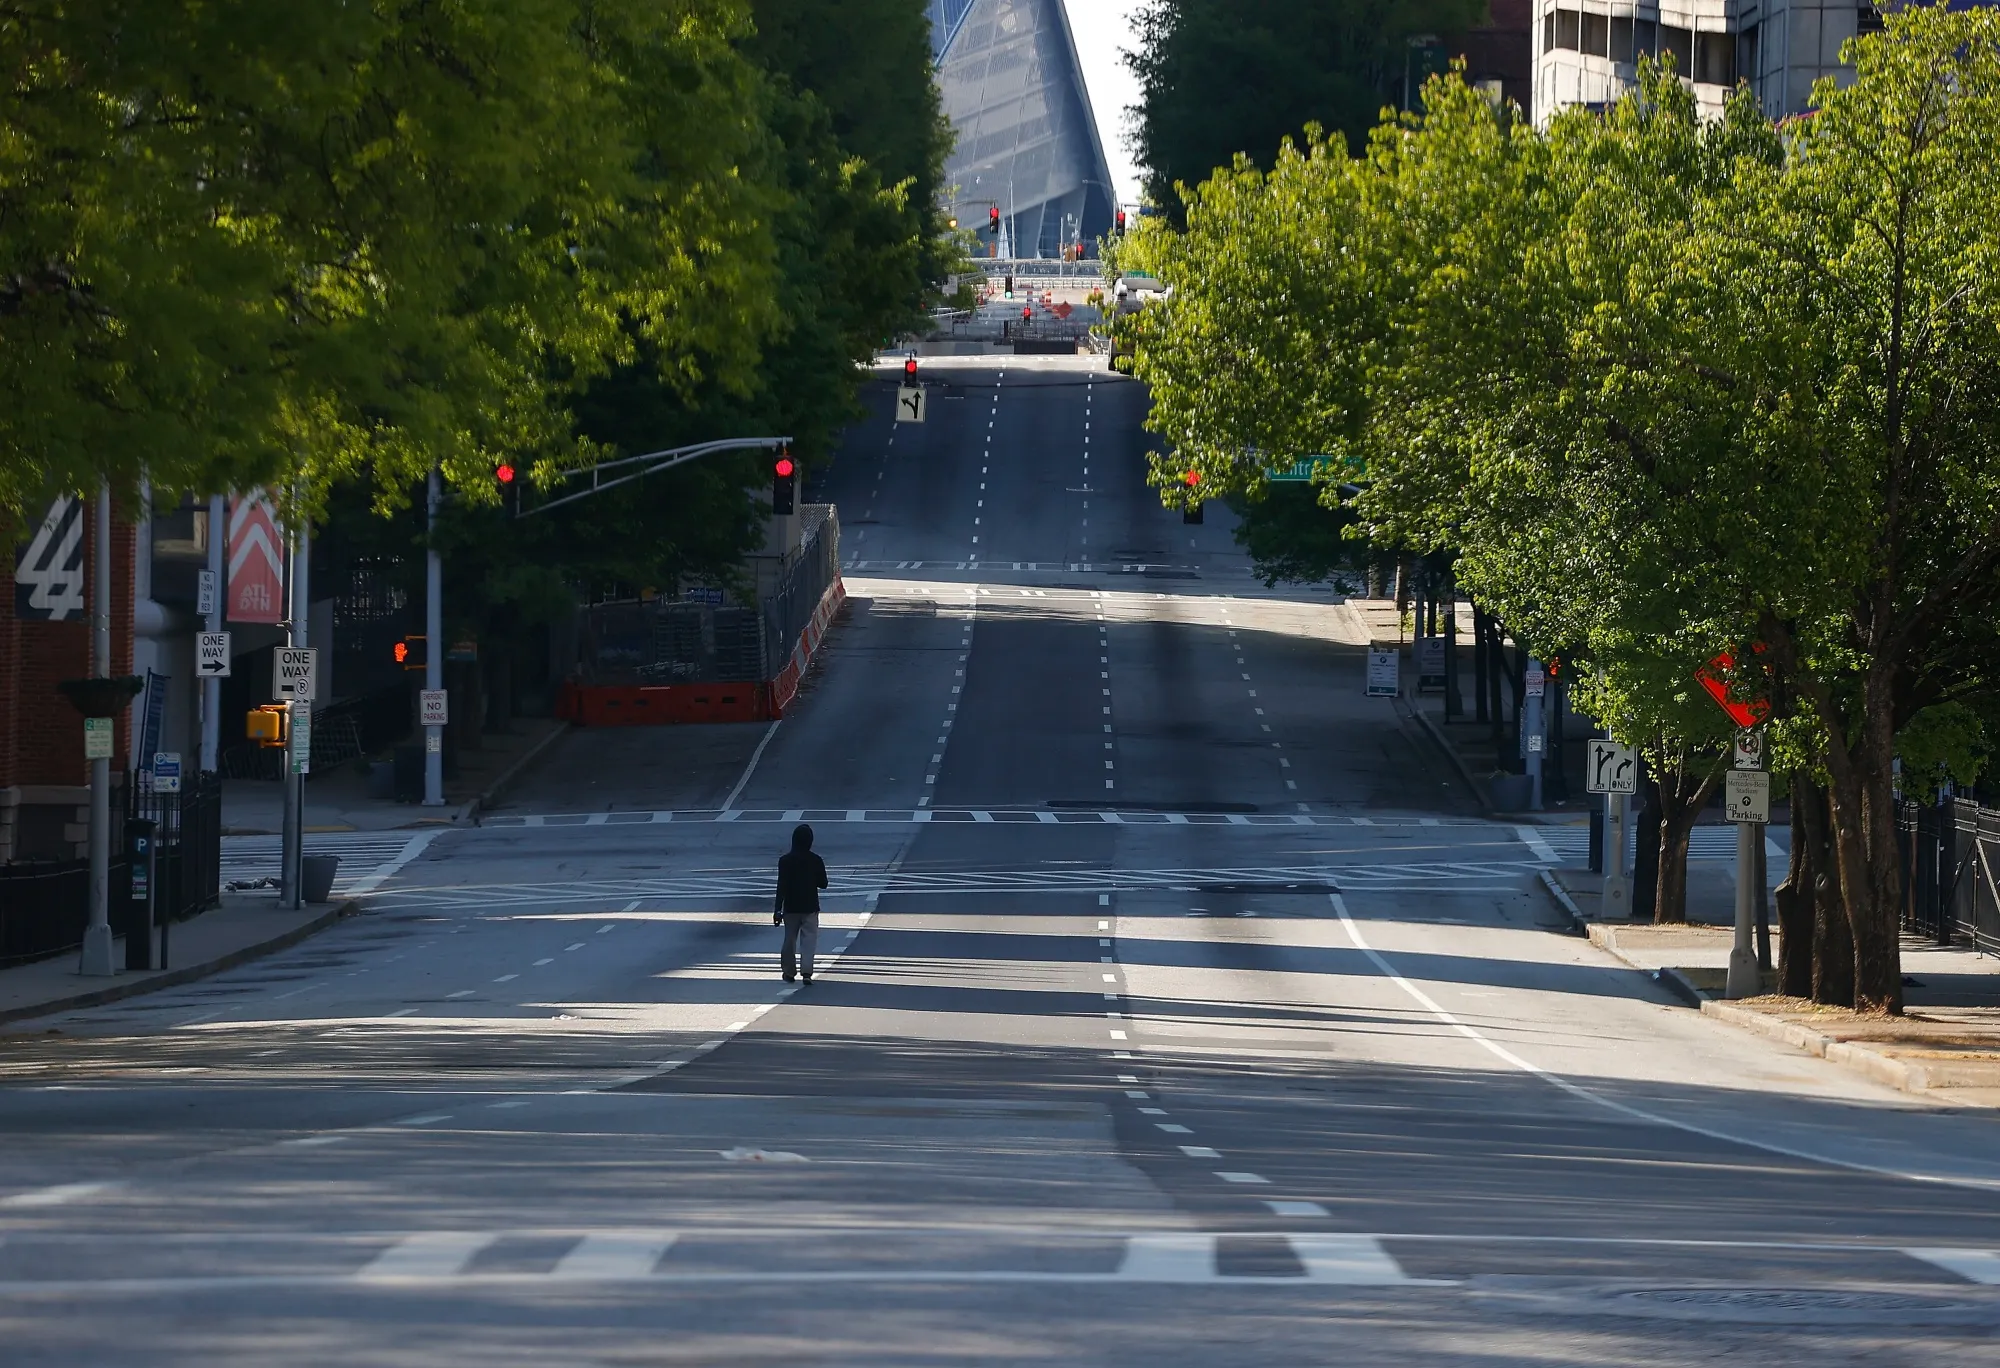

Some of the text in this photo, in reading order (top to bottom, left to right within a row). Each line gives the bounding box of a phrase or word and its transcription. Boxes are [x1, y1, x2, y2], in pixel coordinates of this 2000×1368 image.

[242, 584, 270, 597] ATL
[240, 597, 270, 610] DTN
[202, 636, 224, 646] ONE
[202, 648, 224, 658] WAY
[282, 652, 310, 664] ONE
[282, 666, 310, 678] WAY
[427, 702, 442, 710] NO
[1612, 780, 1632, 788] ONLY
[1732, 810, 1763, 820] Parking
